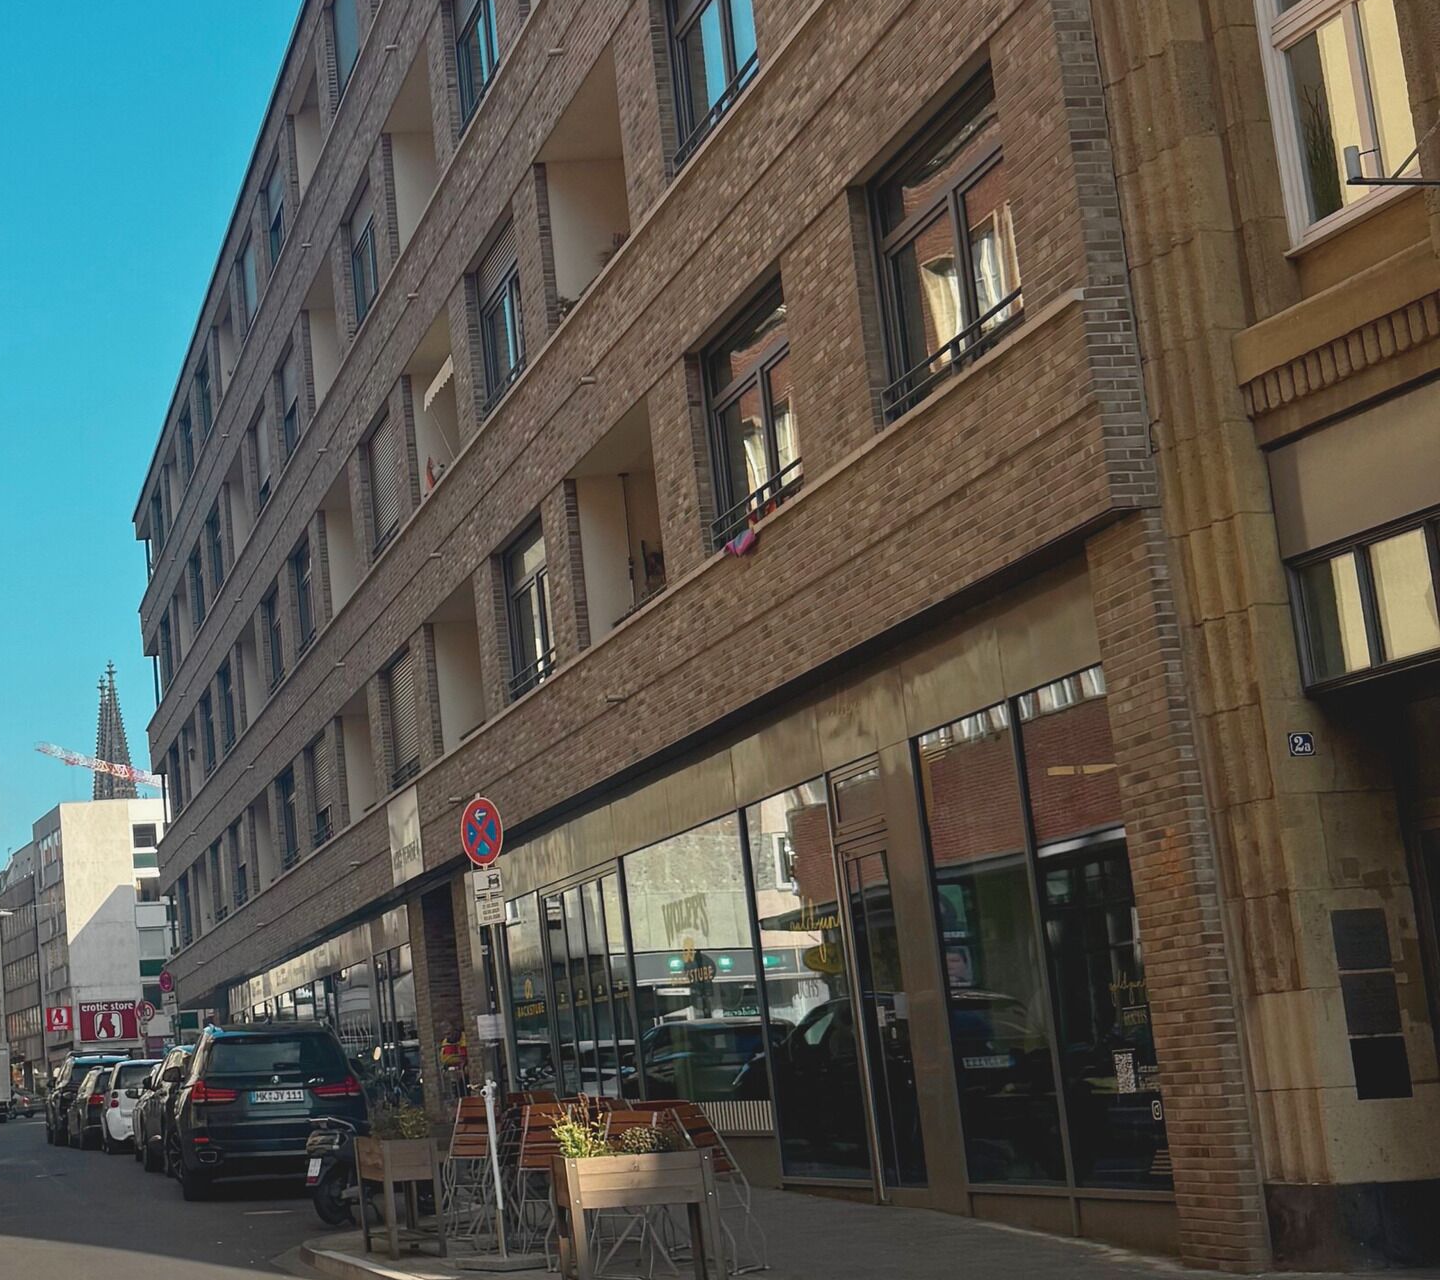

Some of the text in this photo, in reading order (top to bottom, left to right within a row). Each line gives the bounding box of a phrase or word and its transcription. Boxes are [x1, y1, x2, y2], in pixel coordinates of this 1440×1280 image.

[1293, 736, 1311, 752] 2a
[81, 1001, 134, 1012] erotic store
[287, 1090, 302, 1100] 111
